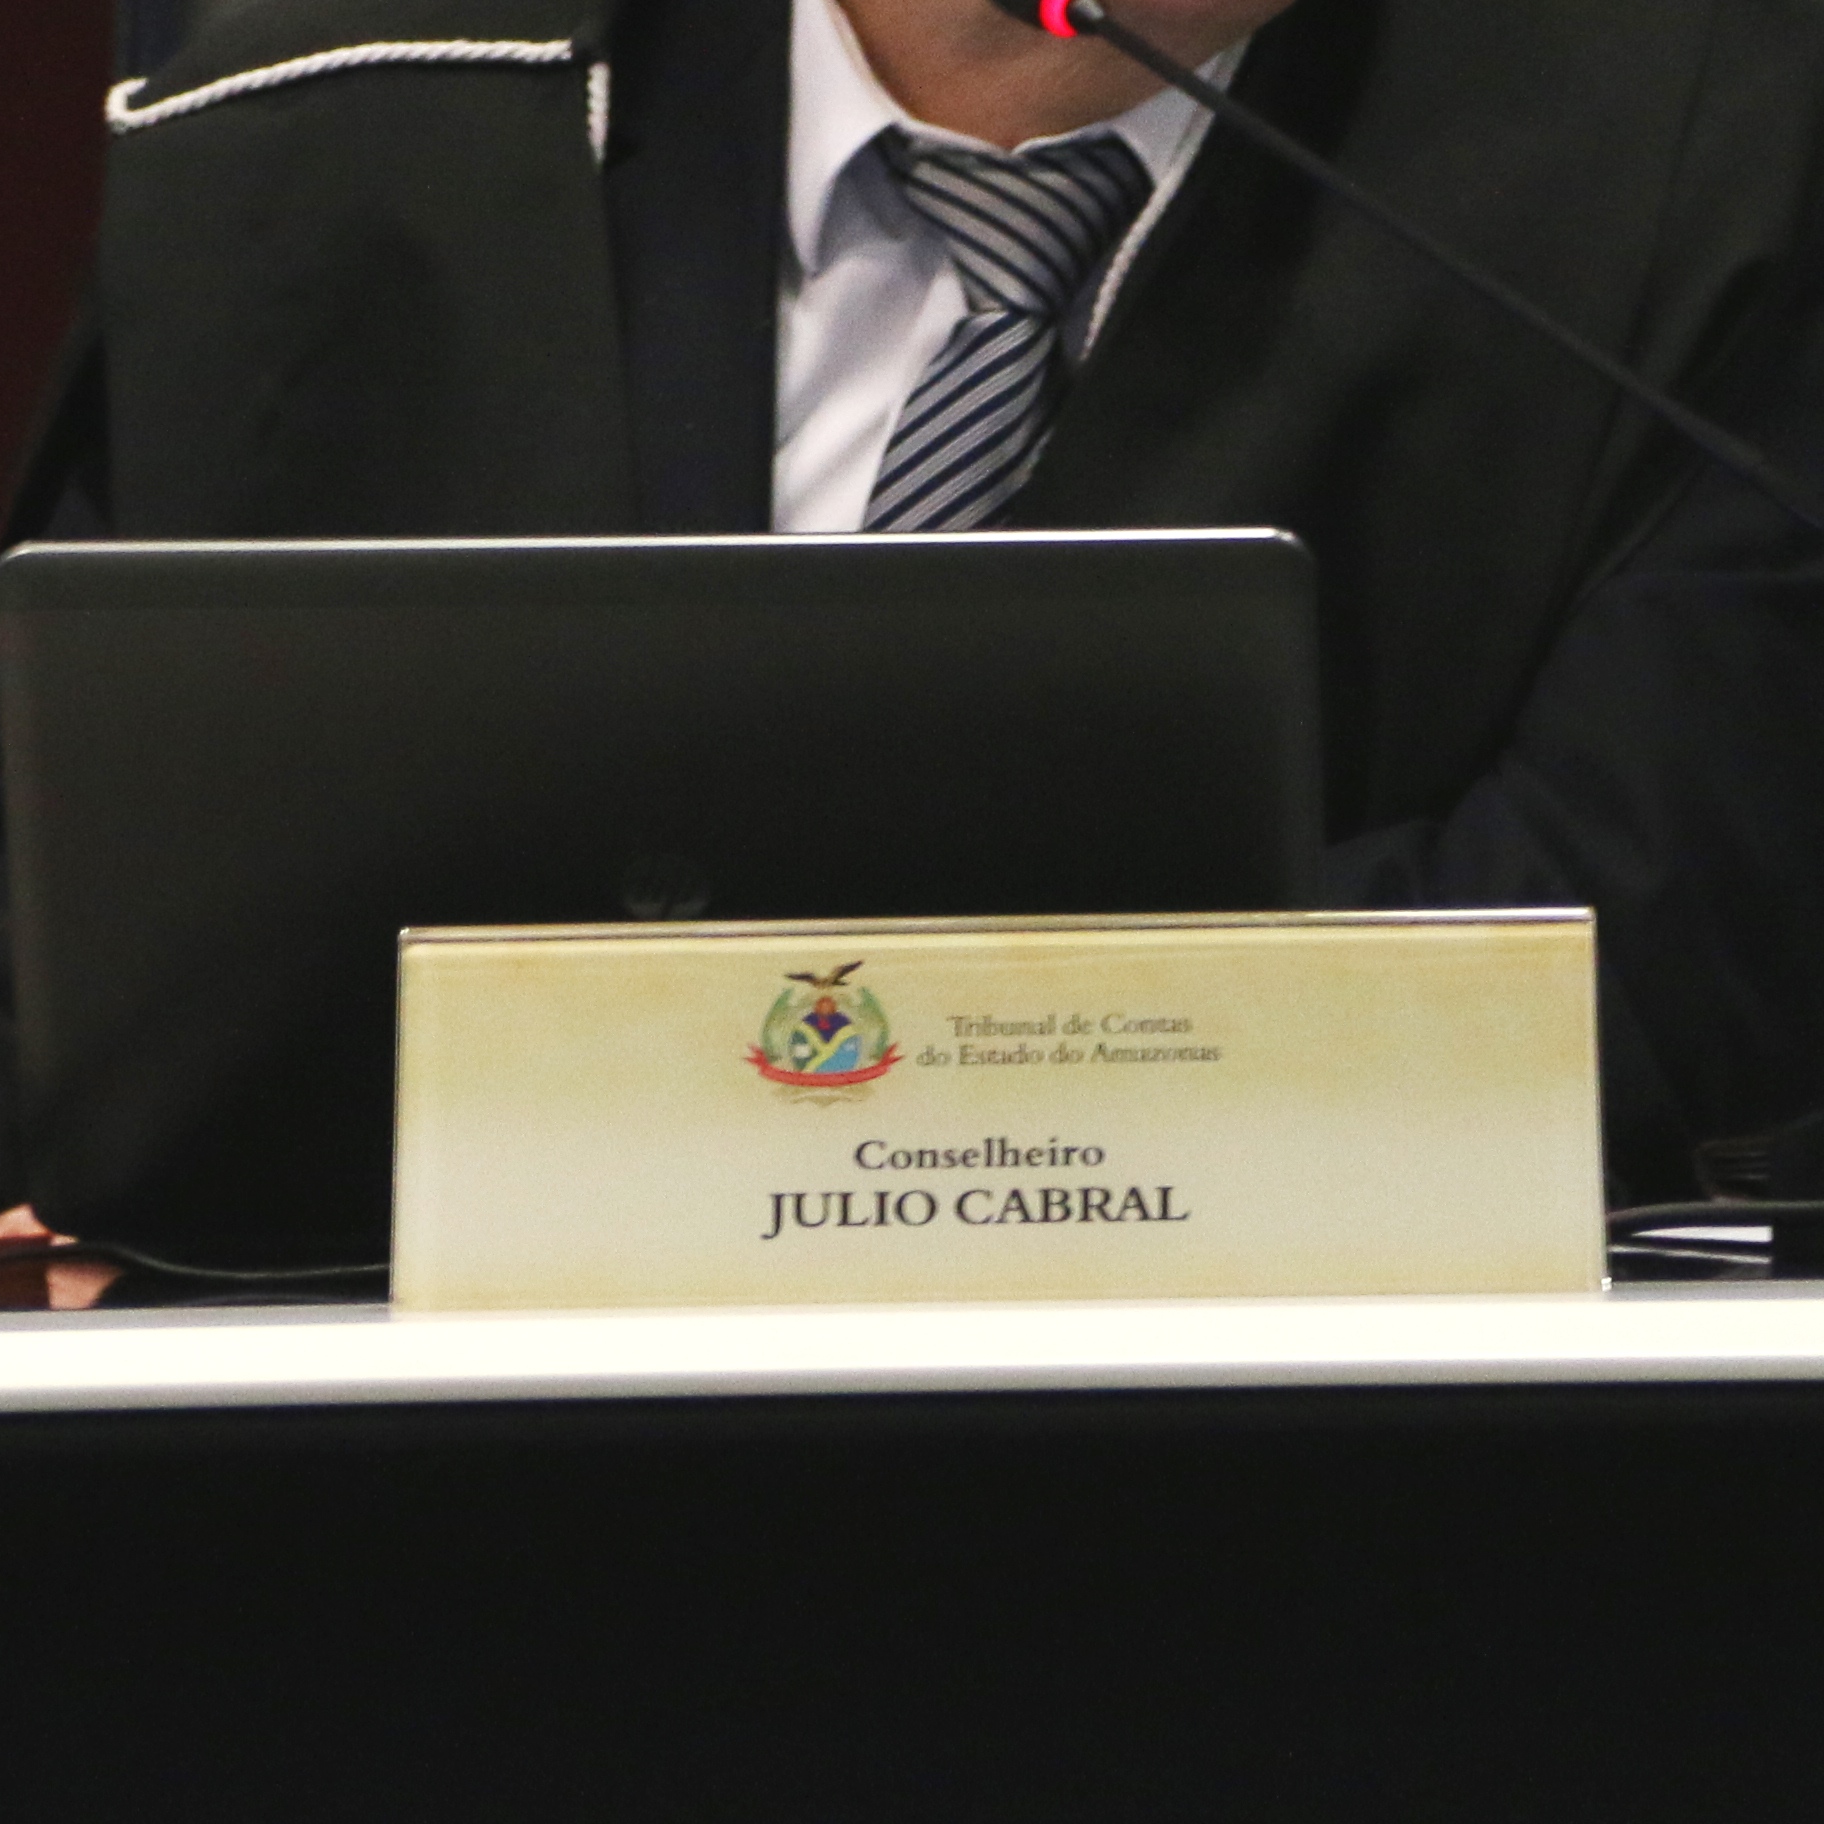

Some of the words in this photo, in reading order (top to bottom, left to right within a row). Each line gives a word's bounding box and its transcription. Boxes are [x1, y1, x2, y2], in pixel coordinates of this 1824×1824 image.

[946, 1013, 1057, 1037] Tribunal
[1061, 1014, 1093, 1035] de
[1100, 1013, 1193, 1035] Contas
[916, 1045, 952, 1067] do
[958, 1043, 1044, 1065] Estado
[1048, 1042, 1083, 1064] do
[1090, 1042, 1223, 1063] Amazonas
[853, 1136, 1106, 1171] Conselheiro
[761, 1189, 938, 1240] JULIO
[953, 1185, 1192, 1226] CABRAL
